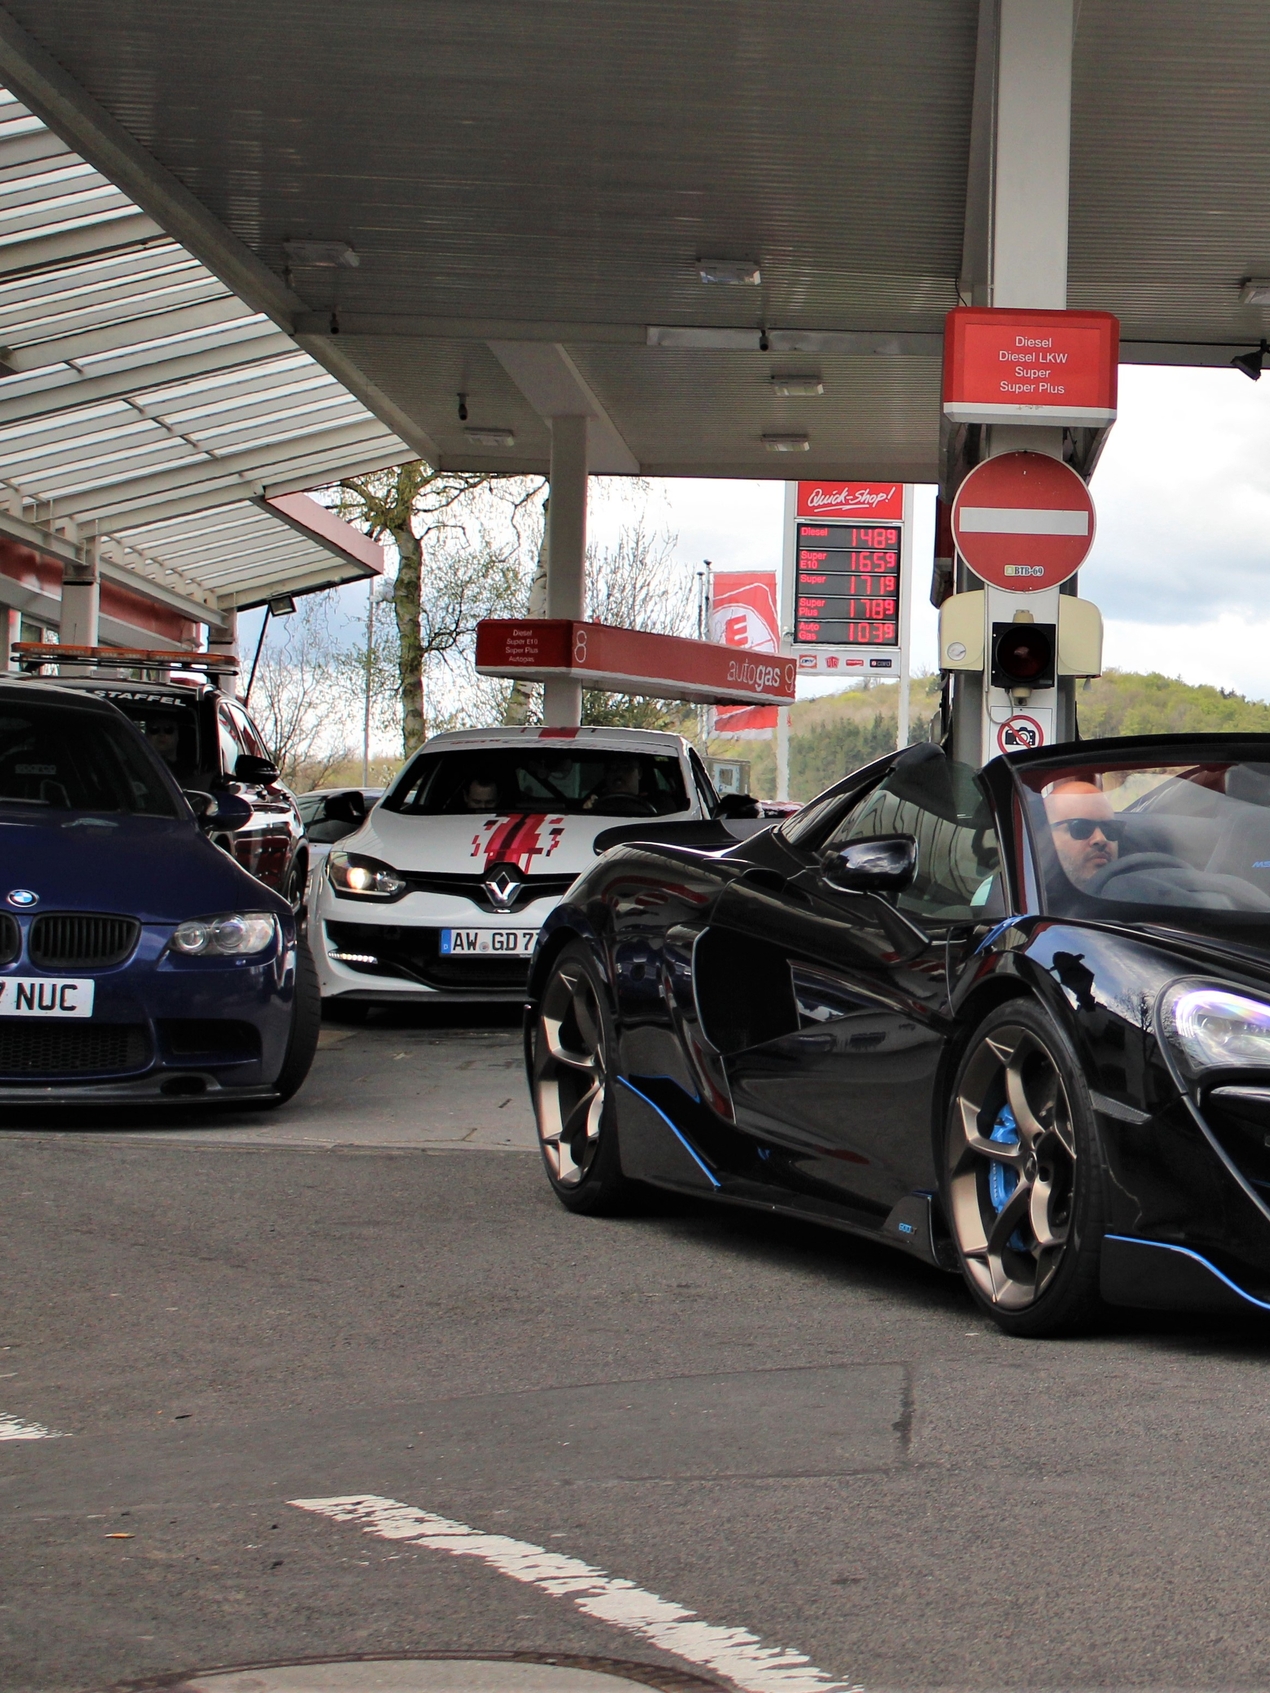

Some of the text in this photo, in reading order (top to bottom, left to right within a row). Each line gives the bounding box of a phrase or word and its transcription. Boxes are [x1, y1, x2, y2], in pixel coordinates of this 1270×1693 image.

[1015, 336, 1052, 348] Diesel
[999, 351, 1068, 363] Diesel LKW
[1015, 367, 1051, 380] Super
[1000, 381, 1065, 394] Super Plus
[807, 486, 896, 509] Quick-Shop!
[801, 527, 897, 549] Diesel 1489
[800, 560, 818, 570] E10
[801, 550, 896, 573] Super 1659
[800, 573, 895, 595] Super 1719
[799, 597, 895, 619] Super 1789
[799, 607, 819, 617] Plus
[512, 629, 533, 637] Diesel
[798, 631, 817, 641] Gas
[799, 622, 895, 643] Auto 1039
[574, 630, 587, 663] 8
[727, 658, 781, 692] autogas
[92, 690, 187, 707] STAFFEL
[453, 932, 539, 951] AW GD 7
[16, 982, 79, 1012] NUC
